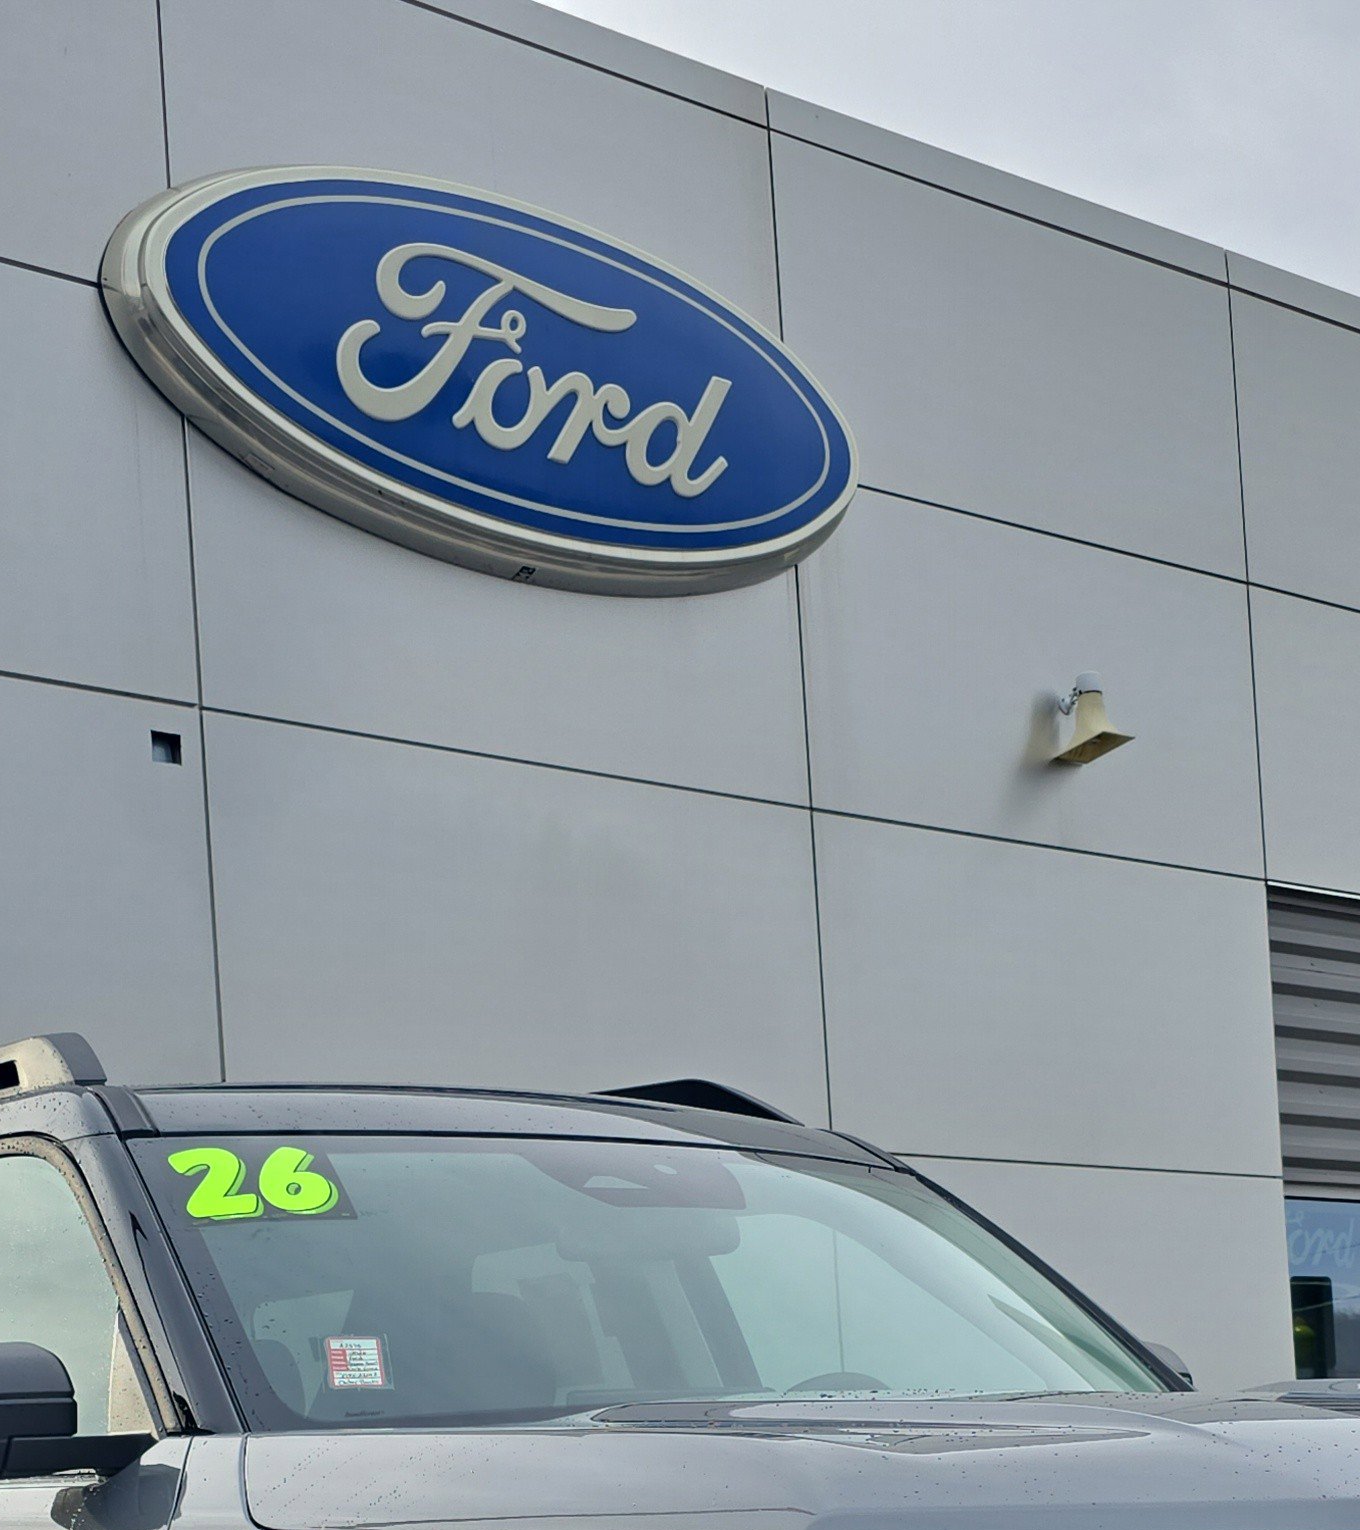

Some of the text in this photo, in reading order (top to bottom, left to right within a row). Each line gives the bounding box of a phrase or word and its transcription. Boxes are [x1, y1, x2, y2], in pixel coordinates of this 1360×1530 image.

[336, 243, 731, 498] Ford
[167, 1146, 338, 1221] 26
[1286, 1209, 1356, 1269] ord
